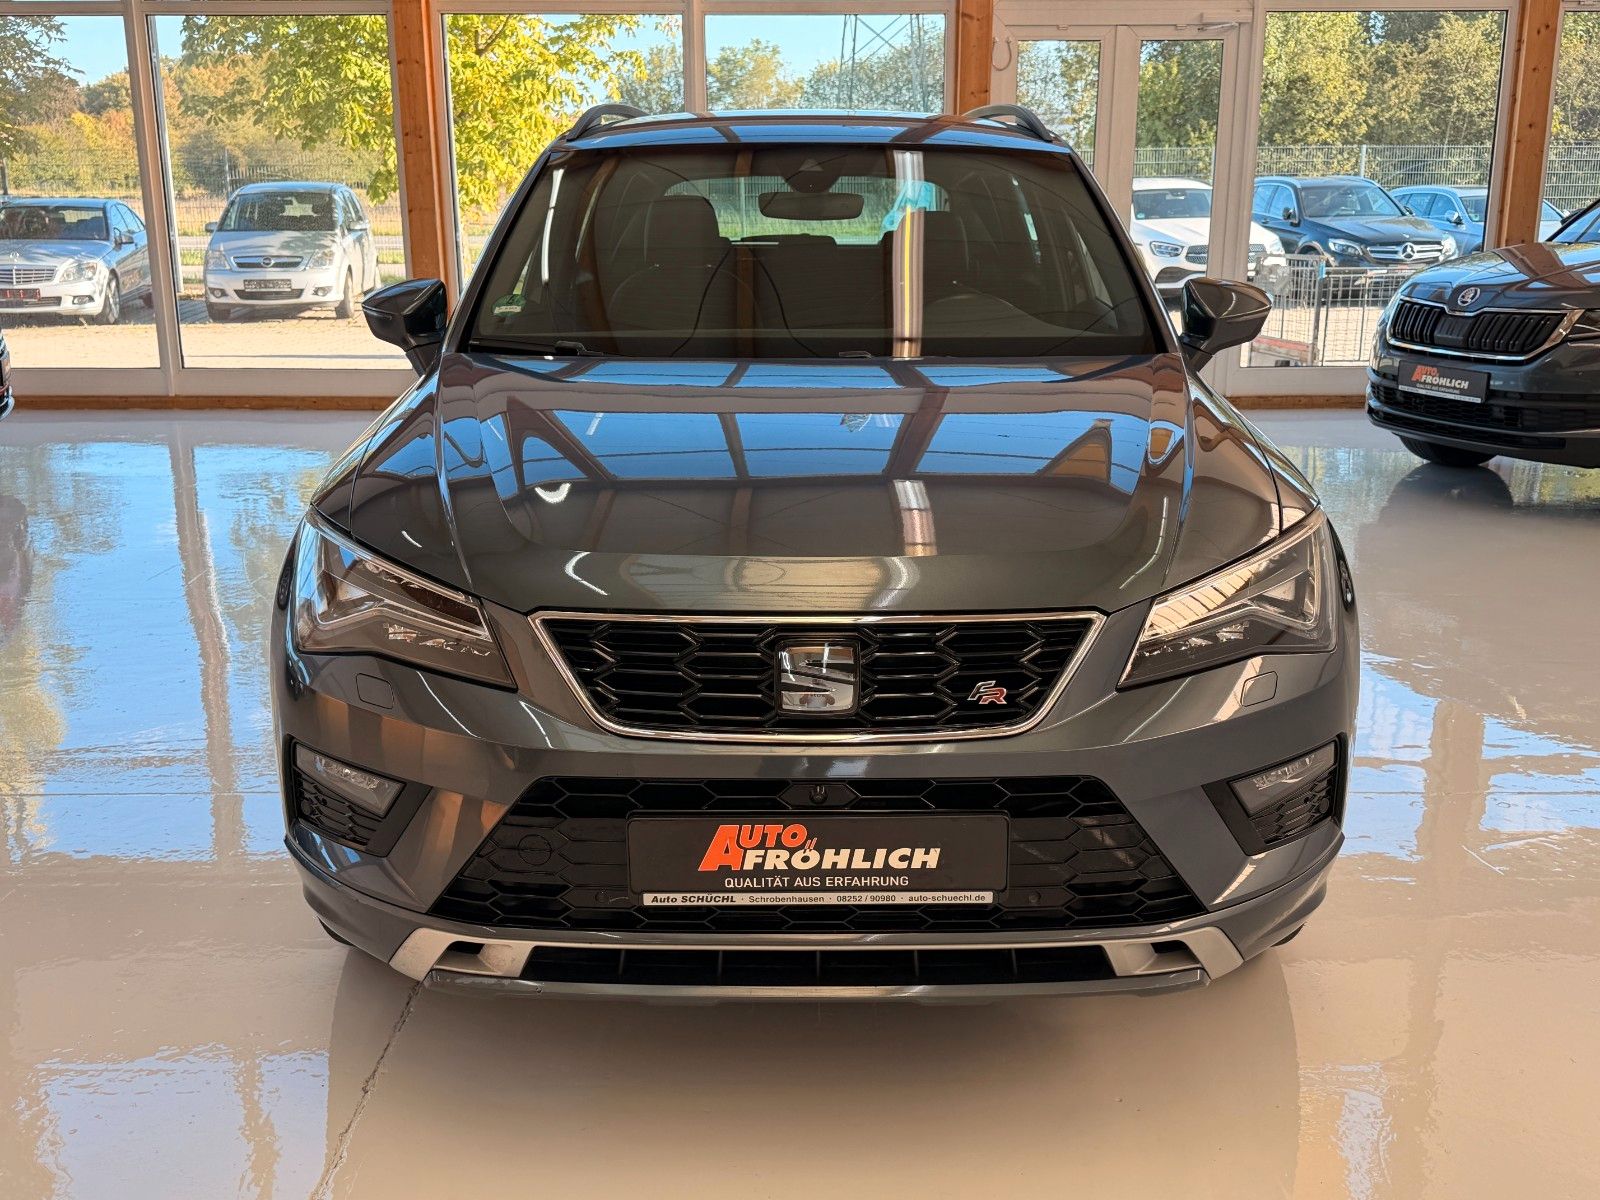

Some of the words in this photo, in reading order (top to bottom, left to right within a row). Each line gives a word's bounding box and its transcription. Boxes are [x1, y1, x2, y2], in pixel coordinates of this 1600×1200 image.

[967, 680, 1007, 704] FR
[698, 823, 808, 871] AUTO
[743, 838, 941, 870] FRÖHLICH
[725, 876, 790, 888] QUALITÄT
[794, 876, 820, 887] AUS
[826, 875, 909, 886] ERFAHRUNG
[651, 895, 678, 903] Auto
[681, 893, 736, 903] SCHÜCHL
[749, 894, 824, 903] Schrobenhausen
[908, 893, 986, 902] auto-schuechl.de
